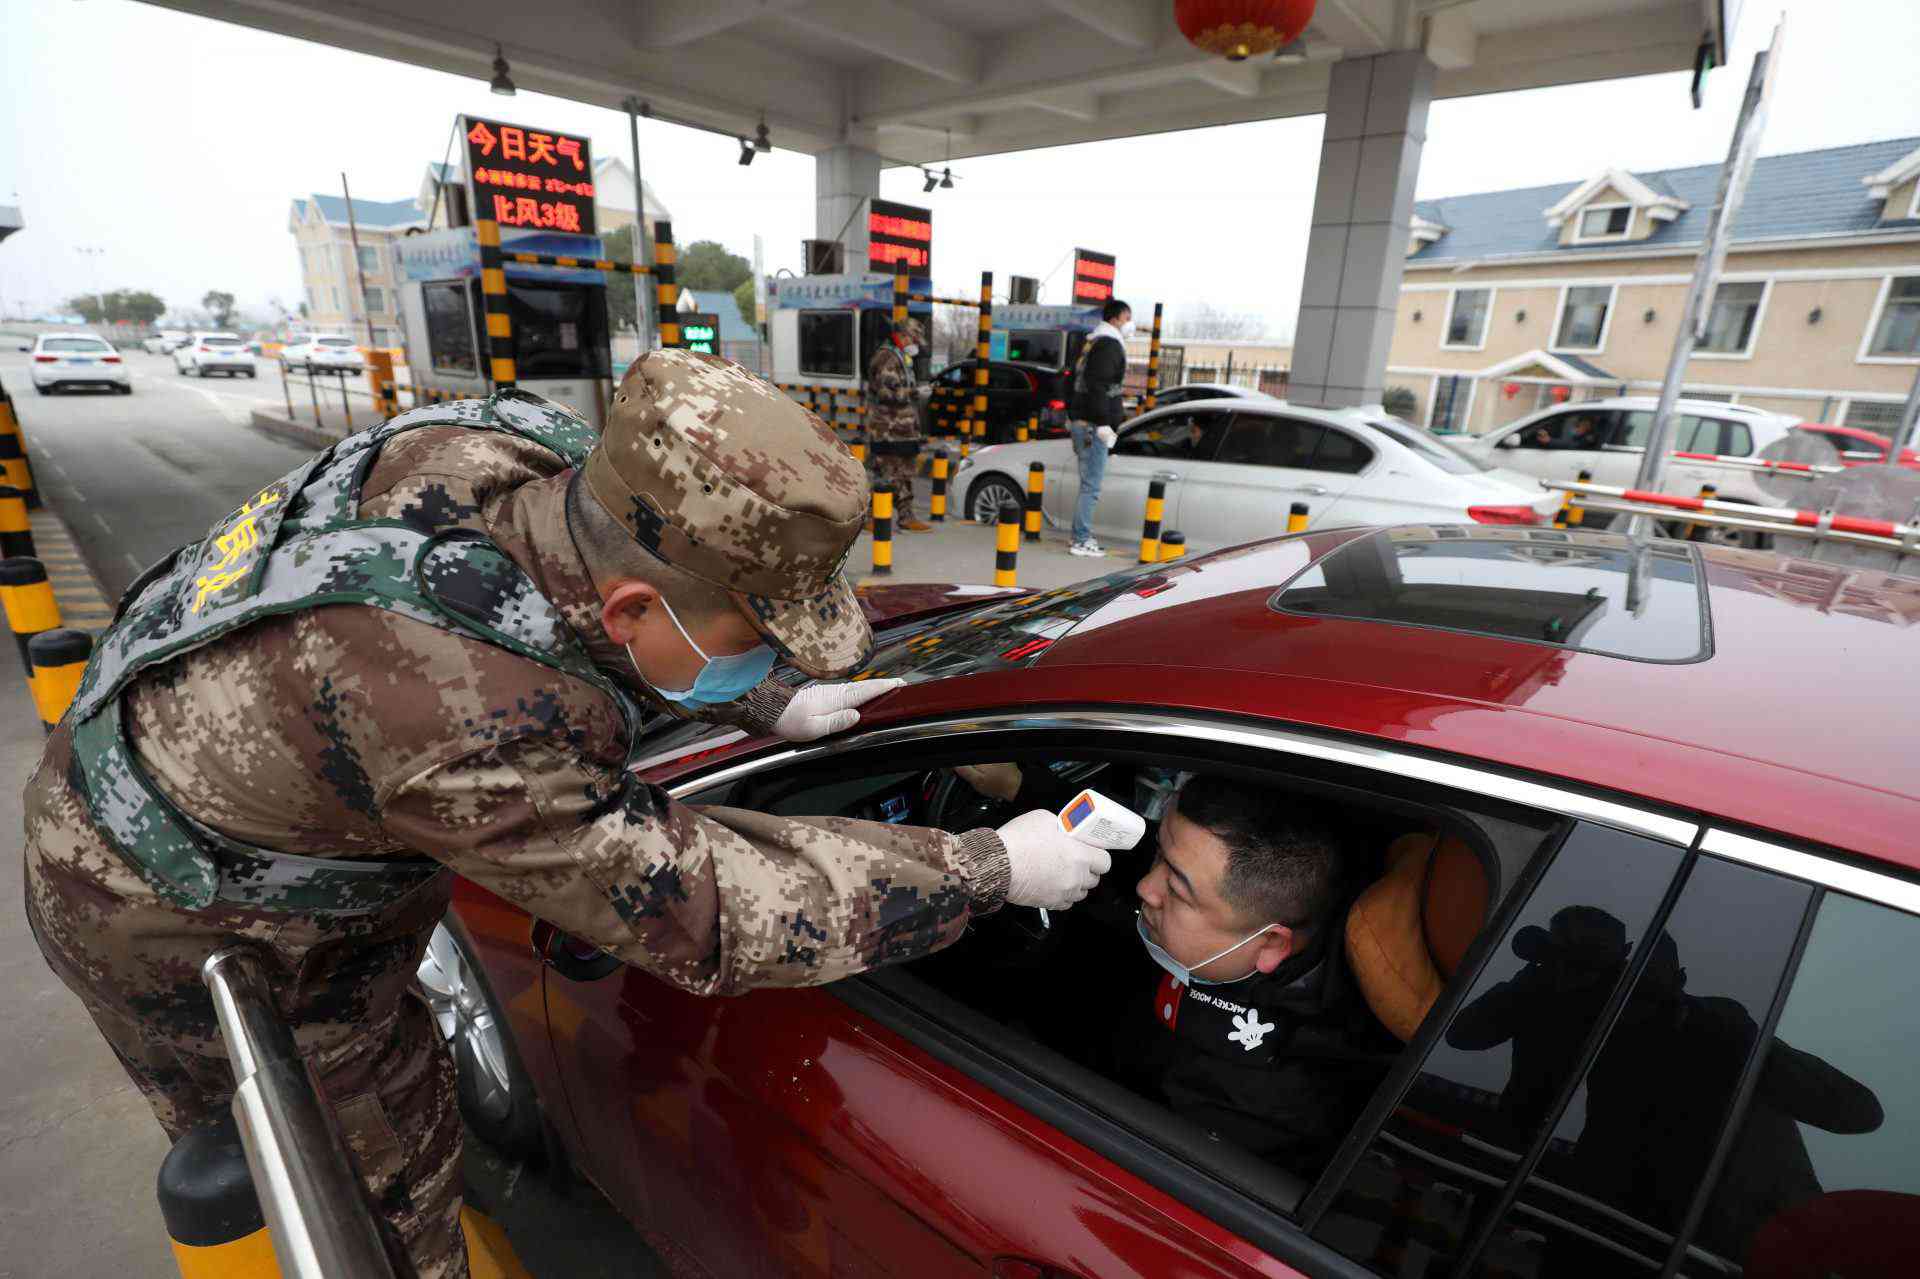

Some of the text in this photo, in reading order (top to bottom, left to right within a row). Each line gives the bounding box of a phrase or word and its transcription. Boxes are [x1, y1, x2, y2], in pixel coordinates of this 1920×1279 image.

[467, 121, 585, 171] 今日天气
[493, 194, 581, 232] 北风3级
[1188, 988, 1247, 1014] MICKEY MOUSE
